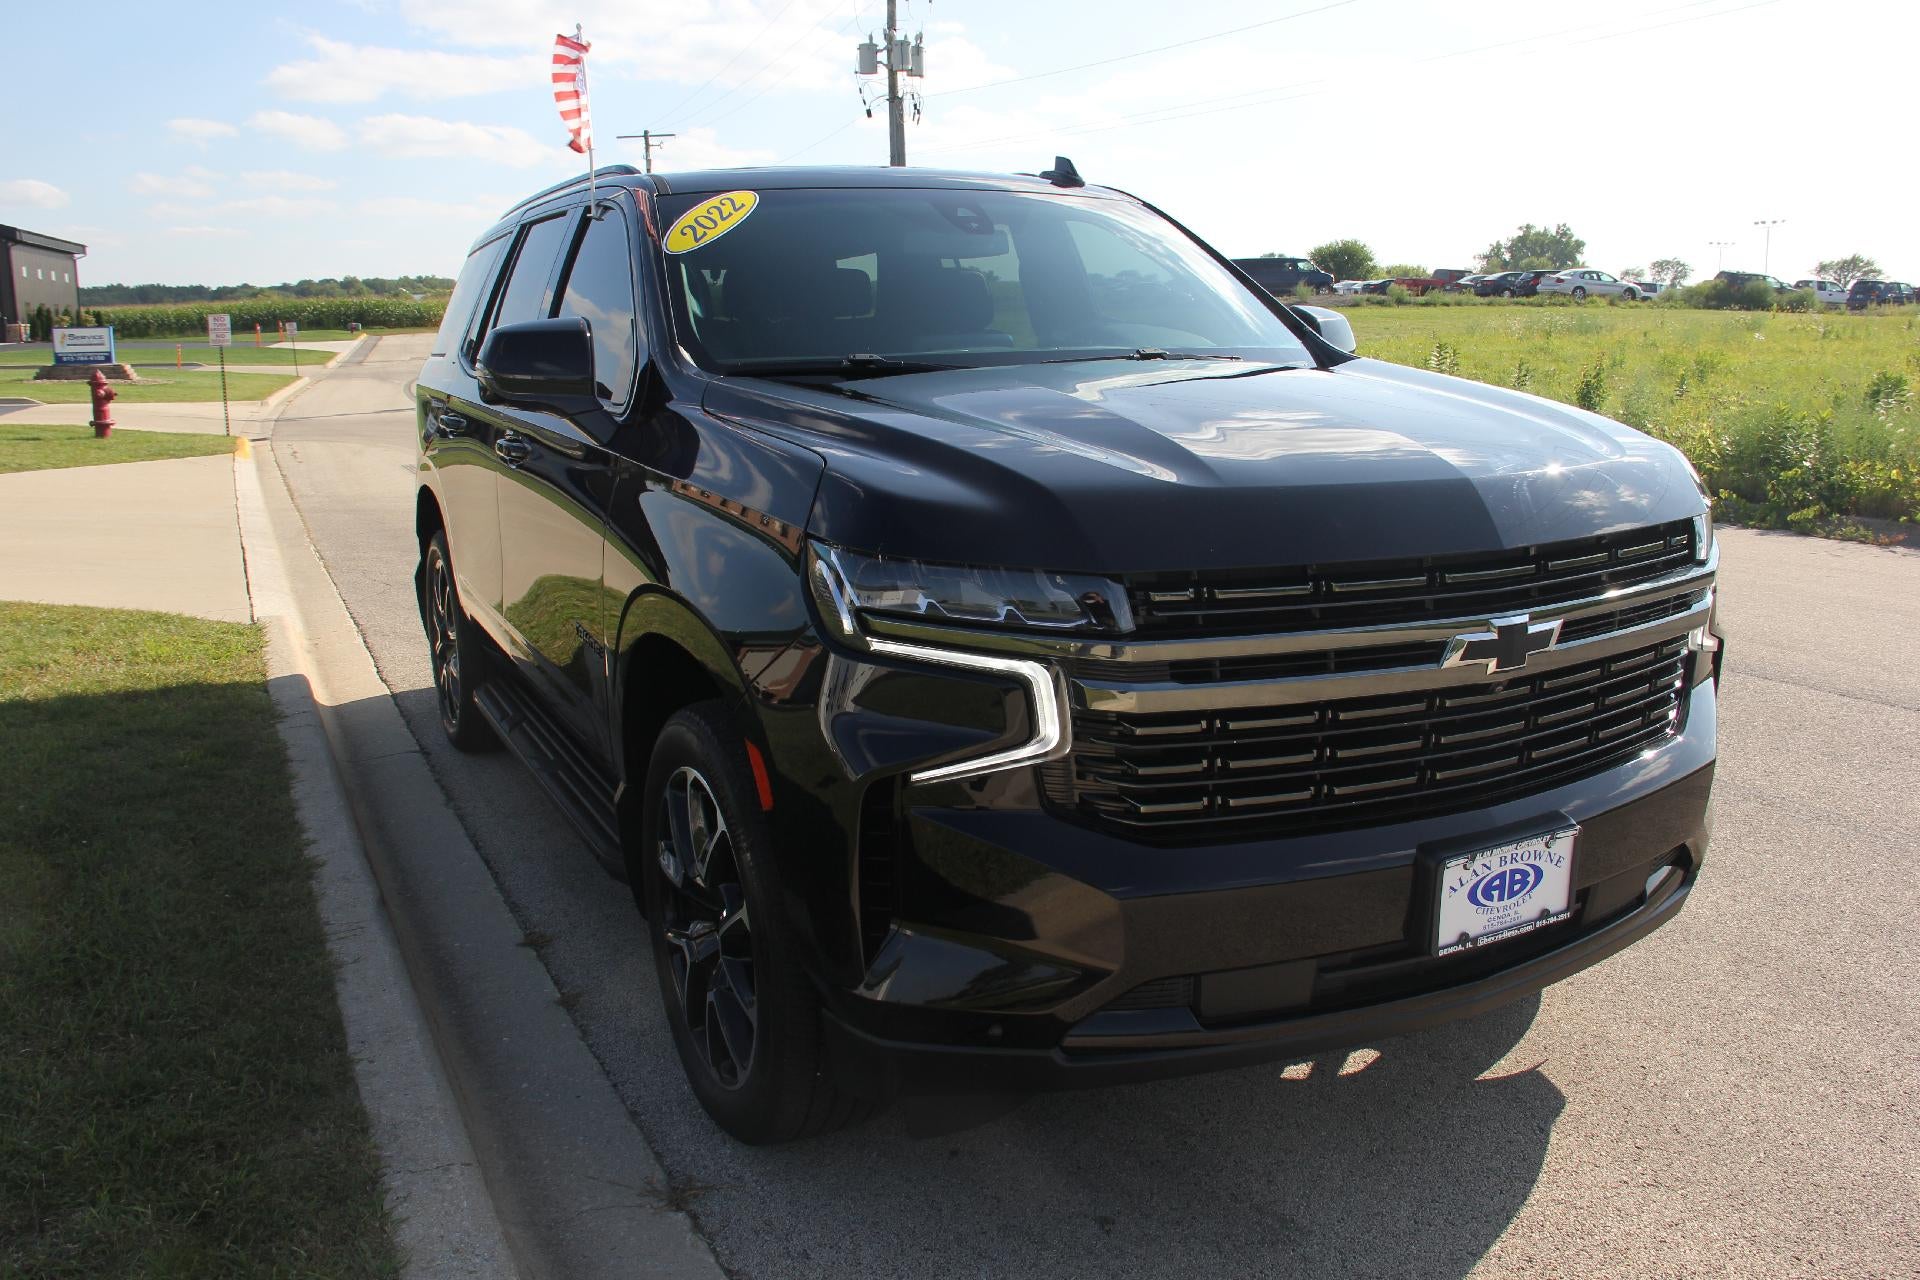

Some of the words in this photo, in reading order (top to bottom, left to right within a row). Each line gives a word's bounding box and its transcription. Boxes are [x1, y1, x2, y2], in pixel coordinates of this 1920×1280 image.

[680, 197, 746, 243] 2022
[1448, 861, 1493, 898] ALAN
[1499, 849, 1565, 869] BROWNE
[1481, 867, 1531, 902] AB
[1475, 892, 1534, 915] CHEVROLET
[1466, 941, 1473, 949] IL
